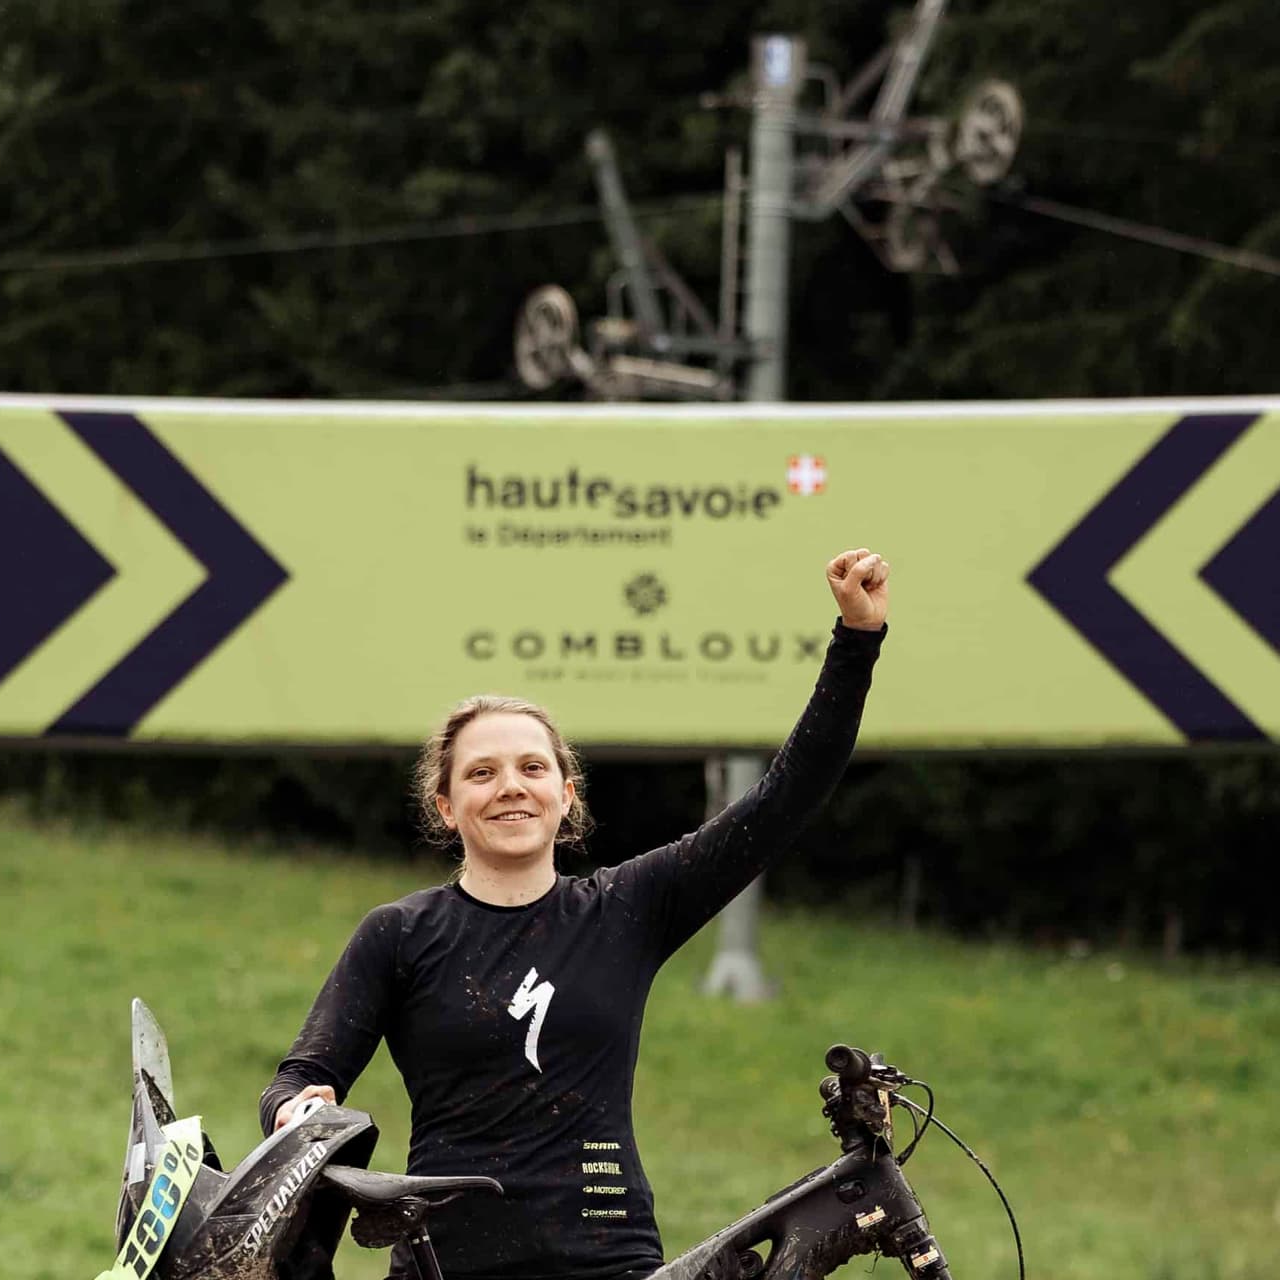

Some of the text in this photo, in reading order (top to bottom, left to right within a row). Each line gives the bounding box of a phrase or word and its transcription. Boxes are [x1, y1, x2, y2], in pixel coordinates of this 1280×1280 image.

[463, 631, 824, 662] COMBLOUX
[122, 1138, 200, 1280] 100%
[241, 1141, 328, 1258] SPECIALIZED
